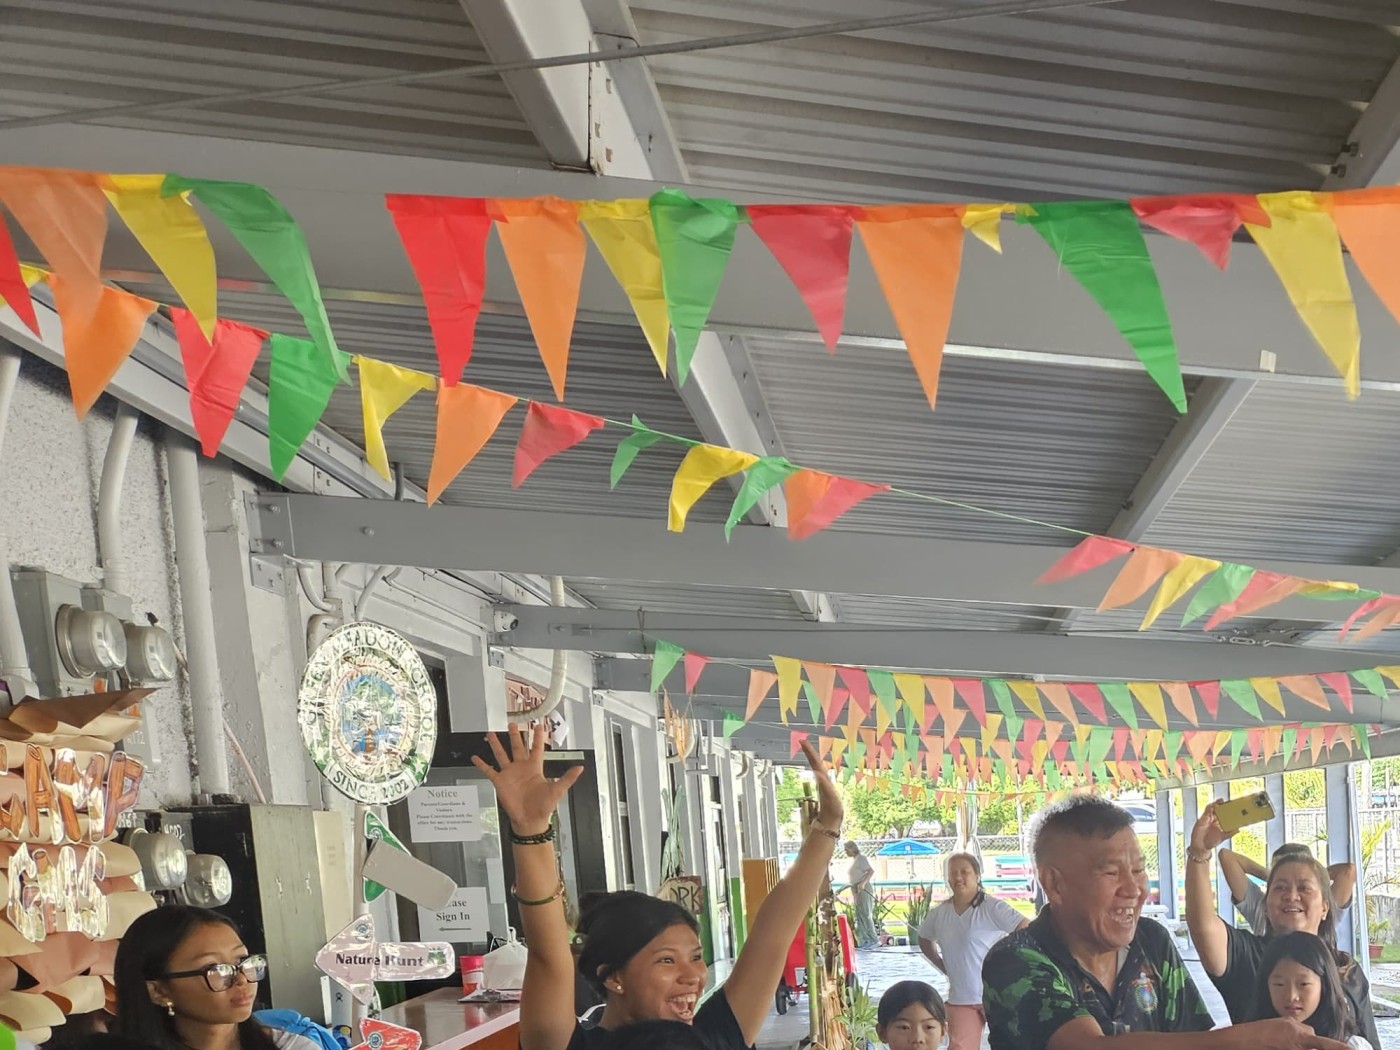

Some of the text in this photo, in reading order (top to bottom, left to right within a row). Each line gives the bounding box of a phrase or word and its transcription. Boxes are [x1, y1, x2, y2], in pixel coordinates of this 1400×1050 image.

[427, 789, 458, 798] Notice
[436, 912, 470, 922] Sign In
[335, 953, 381, 966] Nature
